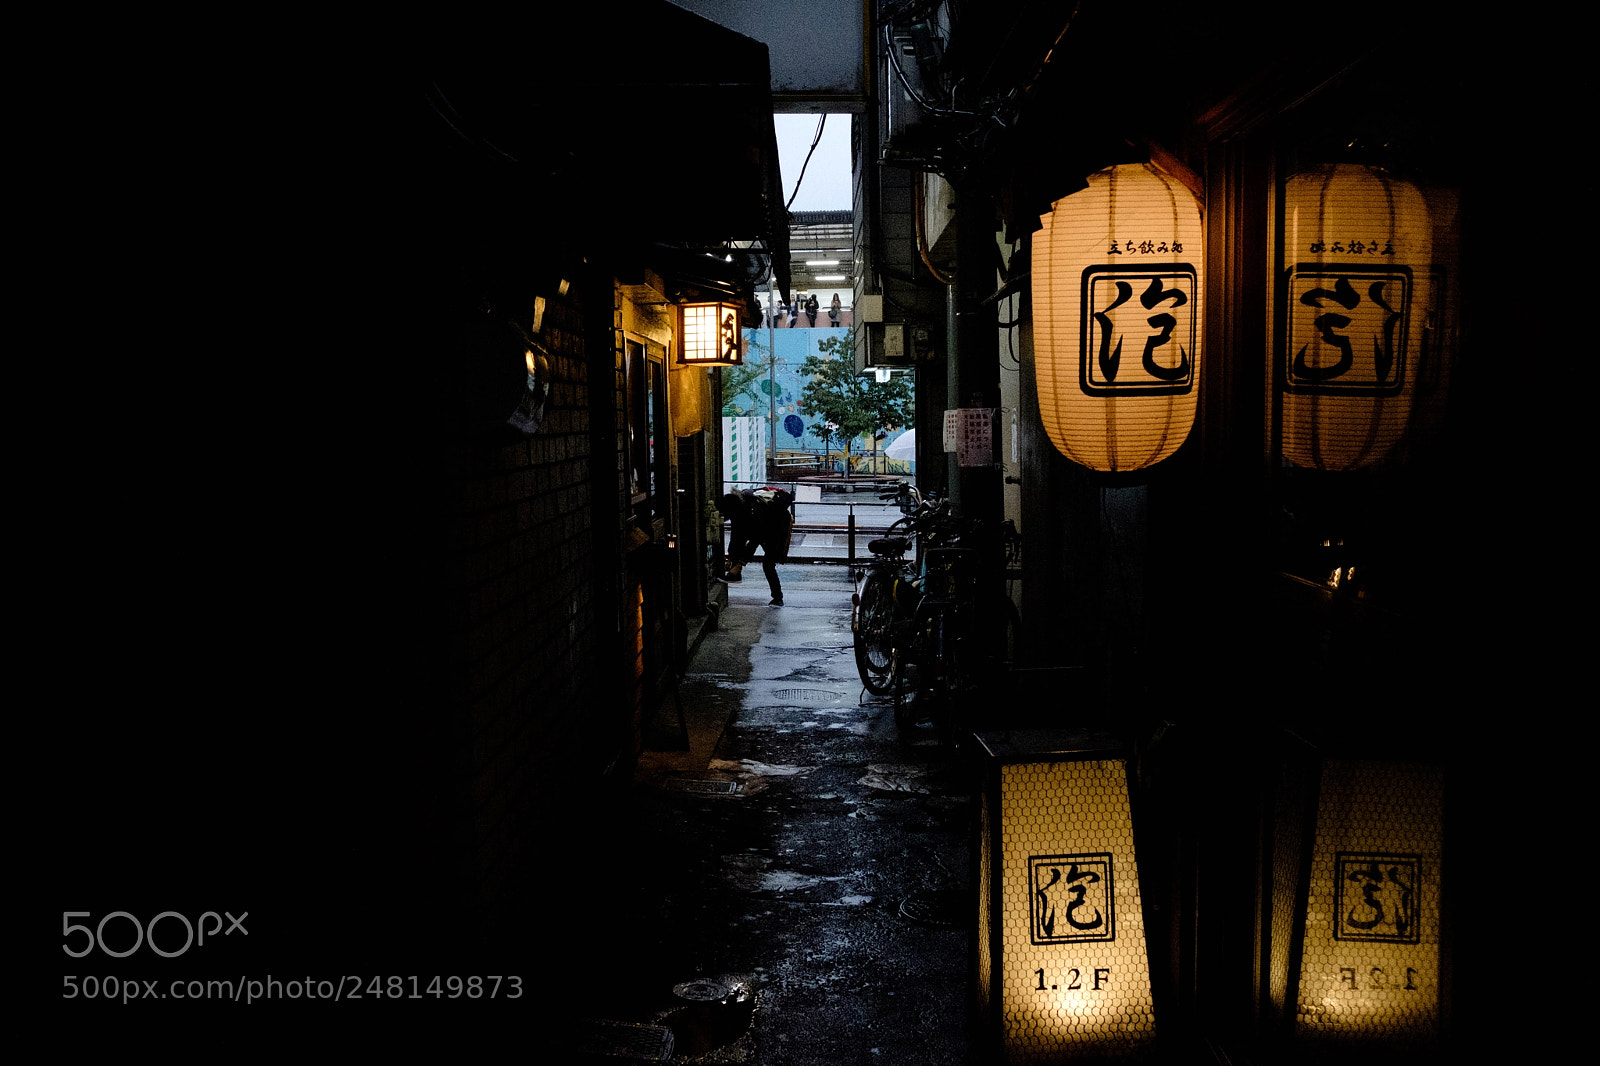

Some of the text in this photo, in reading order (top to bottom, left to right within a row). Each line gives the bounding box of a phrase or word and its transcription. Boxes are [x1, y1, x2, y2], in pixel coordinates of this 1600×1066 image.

[1107, 239, 1183, 255] 立ち飲み処
